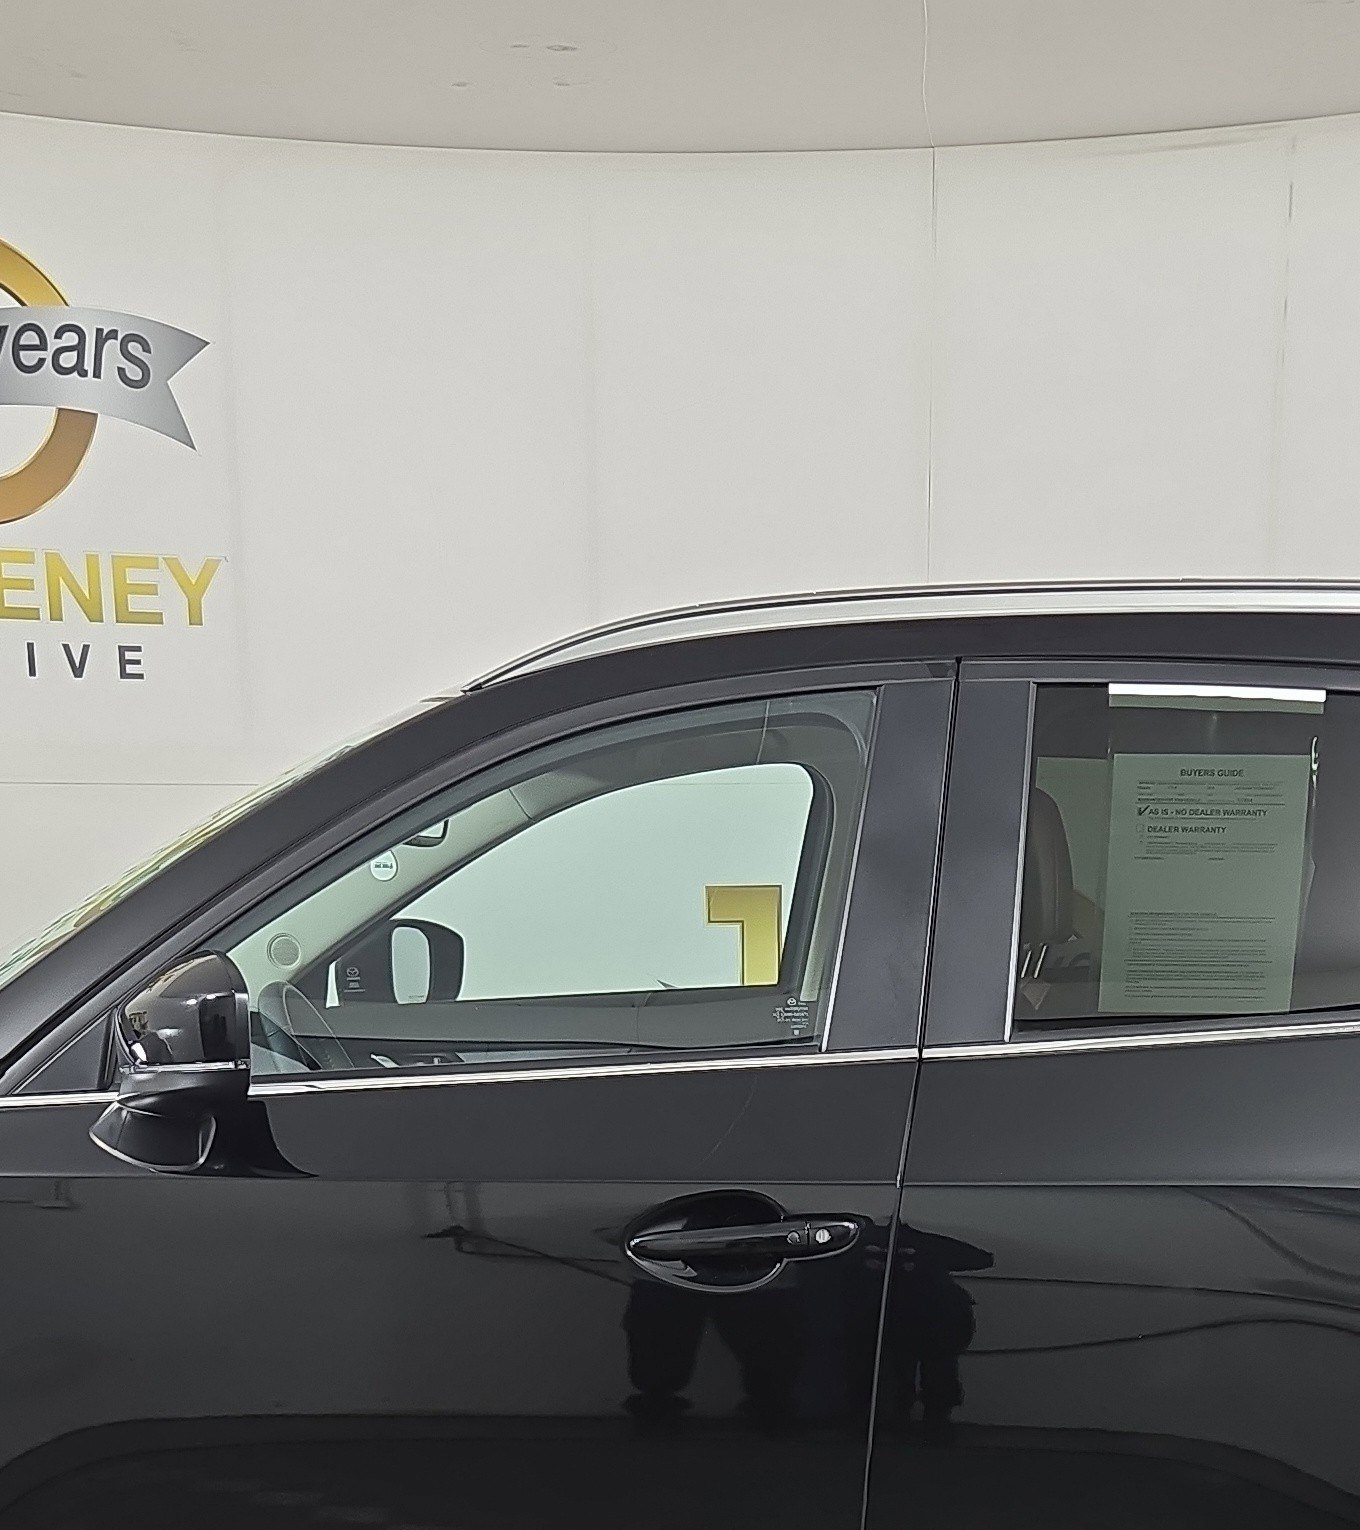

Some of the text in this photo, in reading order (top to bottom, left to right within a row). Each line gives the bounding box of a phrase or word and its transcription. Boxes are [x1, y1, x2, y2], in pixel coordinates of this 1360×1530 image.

[1180, 769, 1244, 777] BUYERS GUIDE
[1223, 809, 1268, 817] WARRANTY
[1181, 826, 1227, 834] WARRANTY
